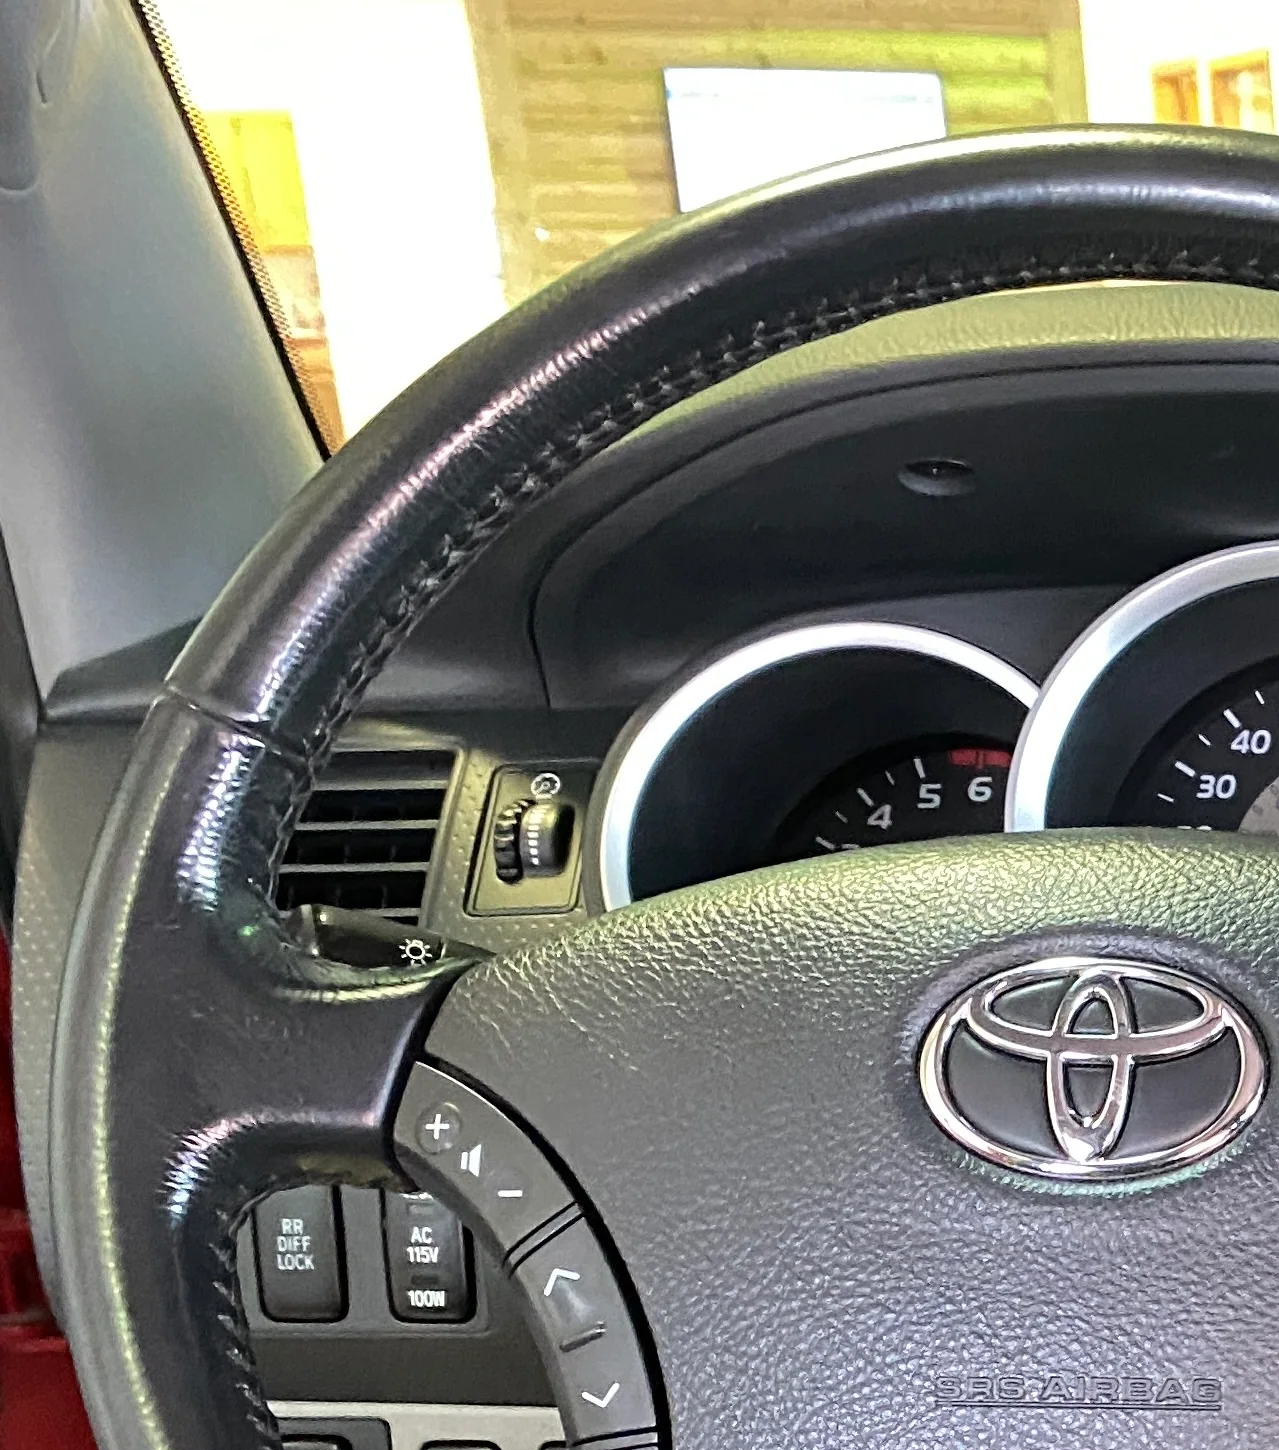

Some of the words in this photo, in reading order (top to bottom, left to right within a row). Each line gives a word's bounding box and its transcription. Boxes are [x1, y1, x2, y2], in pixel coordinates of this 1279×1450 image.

[1230, 729, 1272, 755] 40
[917, 783, 942, 809] 5
[967, 776, 993, 803] 6
[1196, 773, 1237, 800] 30
[867, 804, 892, 830] 4
[281, 1219, 304, 1235] RR
[410, 1227, 433, 1243] AC
[277, 1235, 311, 1252] DIFF
[407, 1246, 439, 1263] 115V
[277, 1253, 315, 1270] LOCK
[408, 1289, 446, 1308] 100W
[936, 1376, 1026, 1399] SRS
[1040, 1376, 1223, 1402] AIRBAG
